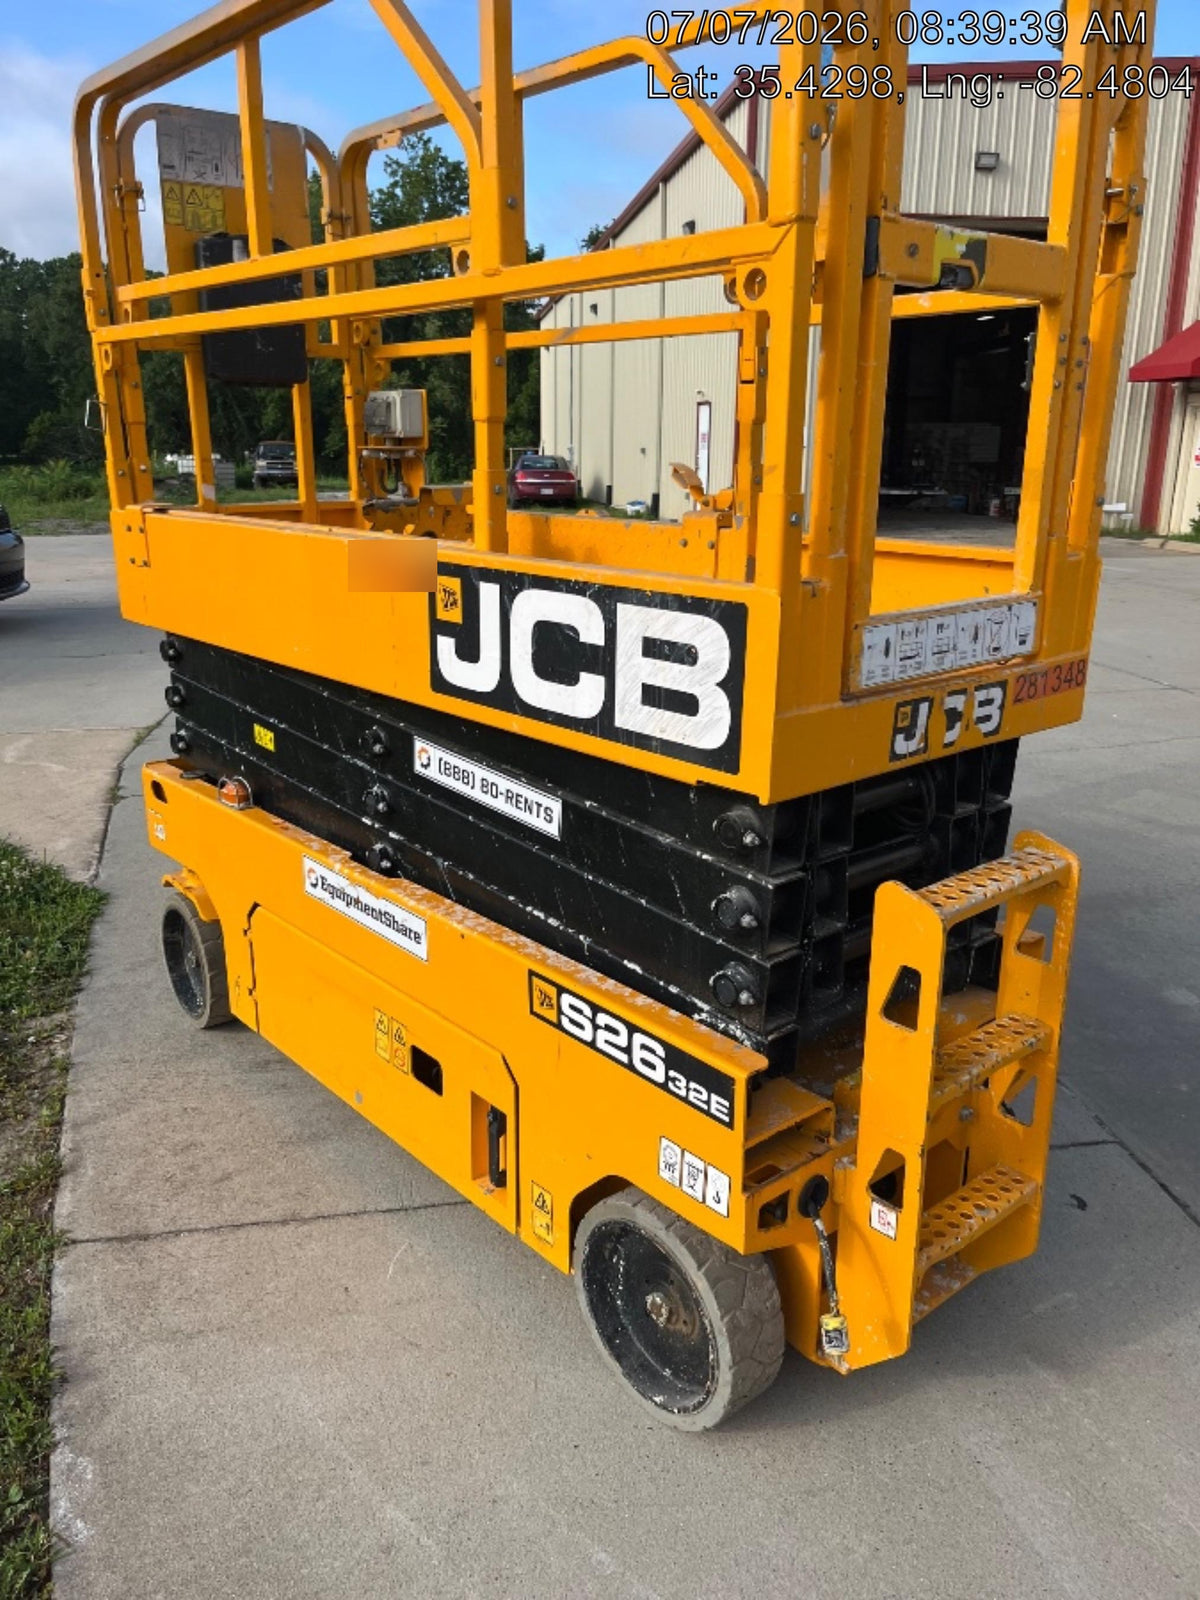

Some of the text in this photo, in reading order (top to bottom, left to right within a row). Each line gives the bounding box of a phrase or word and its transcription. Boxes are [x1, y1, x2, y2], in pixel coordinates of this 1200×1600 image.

[436, 580, 731, 750] JCB
[1014, 659, 1085, 703] 281348
[437, 756, 554, 824] (888) 80-RENTS
[319, 874, 422, 945] EquipmentShare
